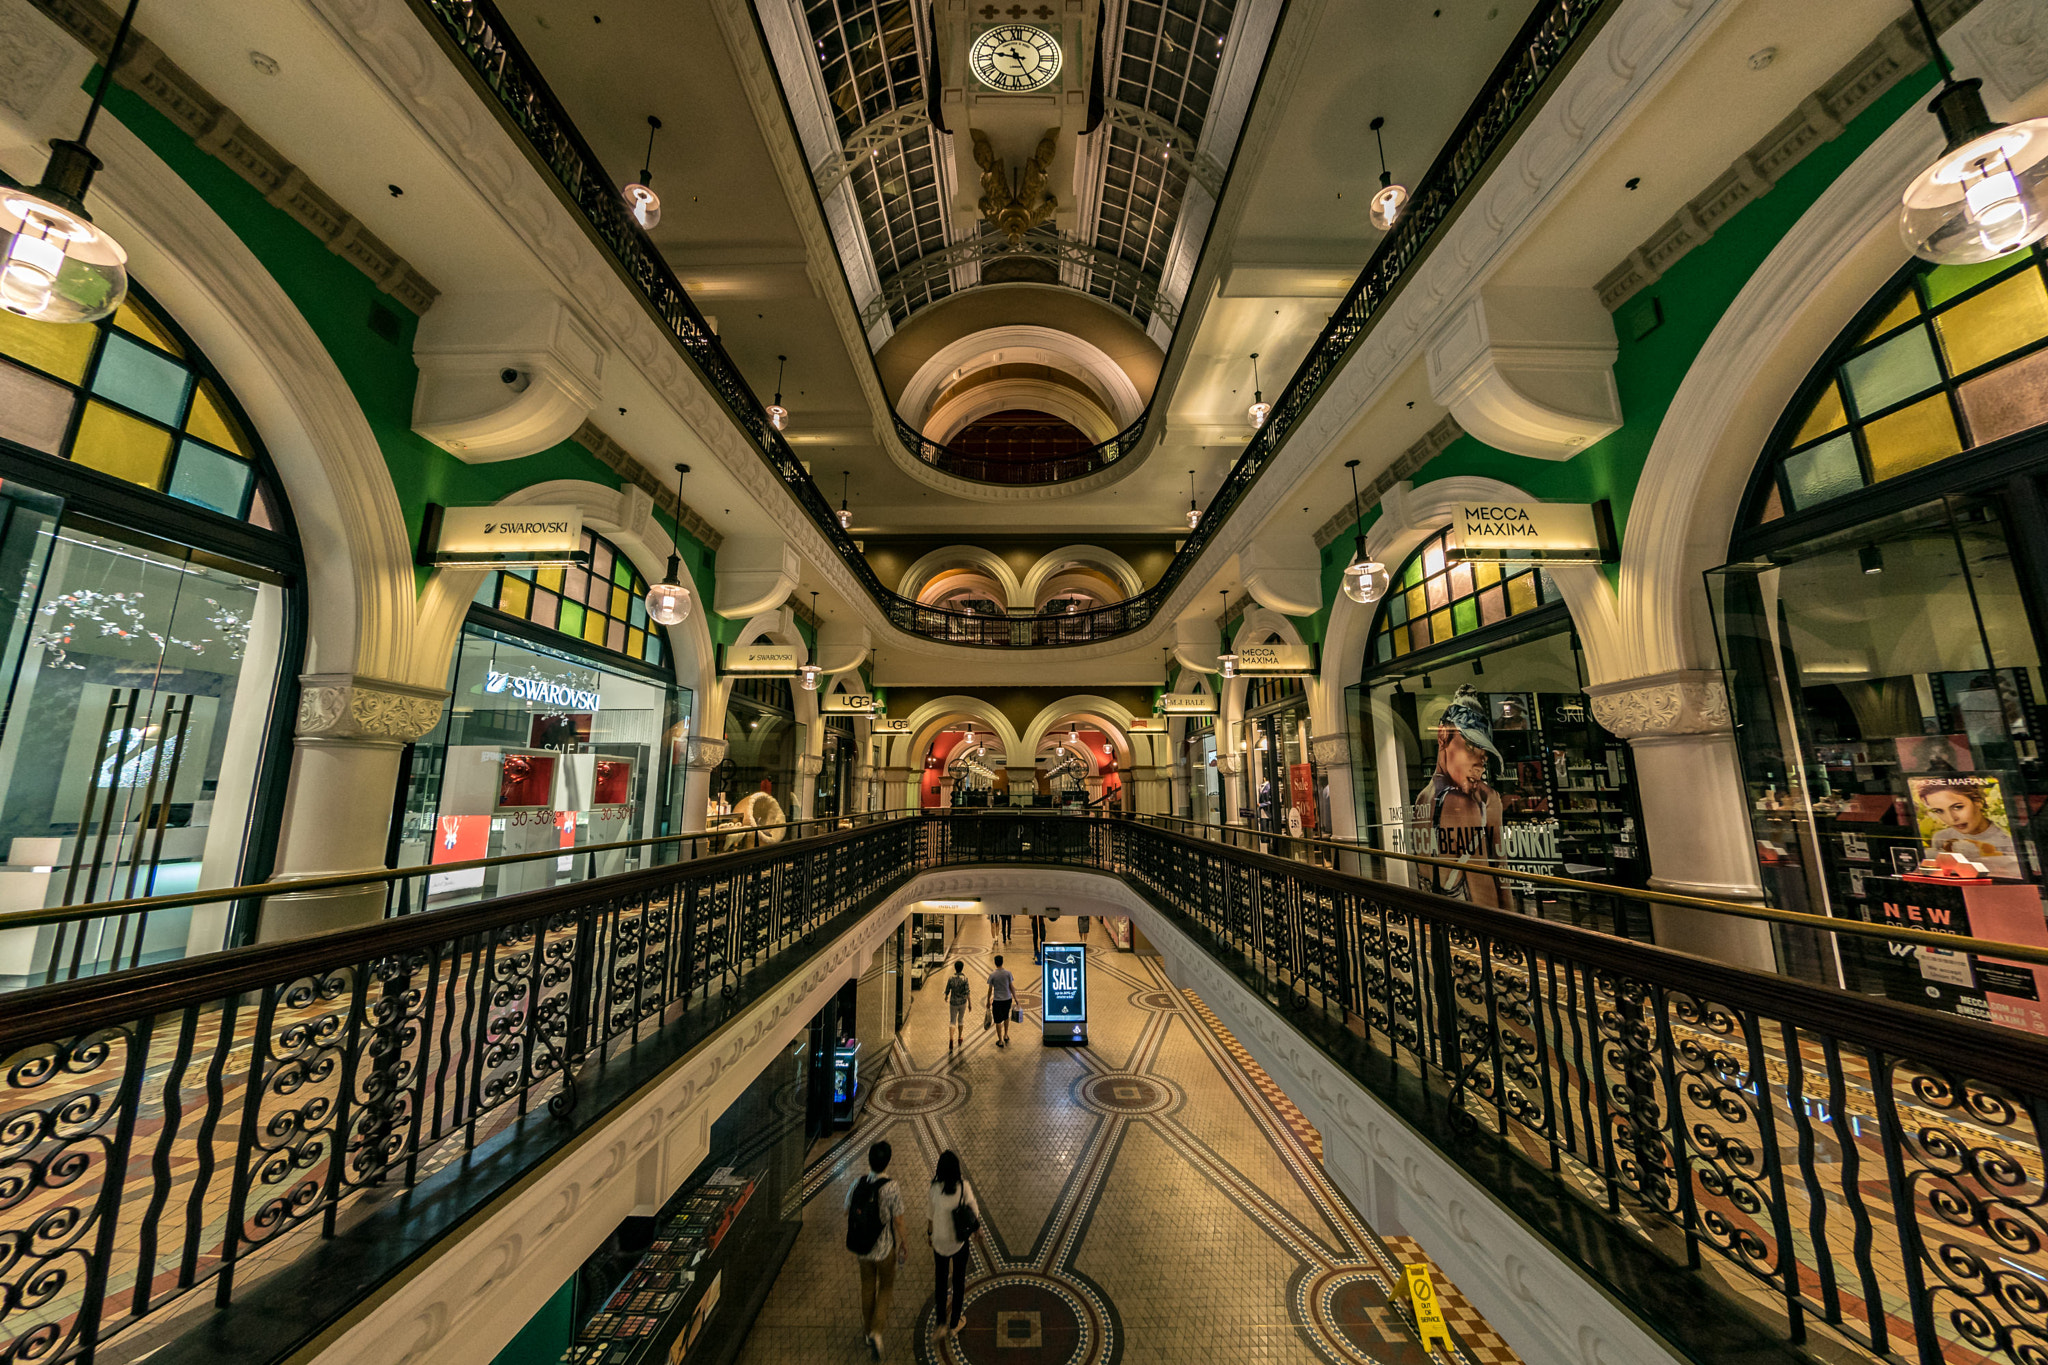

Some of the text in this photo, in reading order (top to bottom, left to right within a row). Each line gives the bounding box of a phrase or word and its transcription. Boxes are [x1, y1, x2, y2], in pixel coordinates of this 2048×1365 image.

[1465, 507, 1529, 521] MECCA
[499, 522, 568, 534] SWAROVSKI
[1467, 522, 1538, 537] MAXIMA
[756, 654, 793, 662] SWAROVSKI
[1242, 648, 1275, 657] MECCA
[1242, 656, 1279, 665] MAXIMA
[512, 677, 600, 712] SWAROVSKI
[842, 696, 870, 708] UGG
[1555, 705, 1595, 723] SKIN
[887, 720, 908, 731] UGG
[1294, 776, 1309, 791] Sale
[1389, 806, 1403, 821] TAKE
[1416, 803, 1431, 819] 2017
[1883, 902, 1951, 925] NEW
[1052, 967, 1078, 991] SALE
